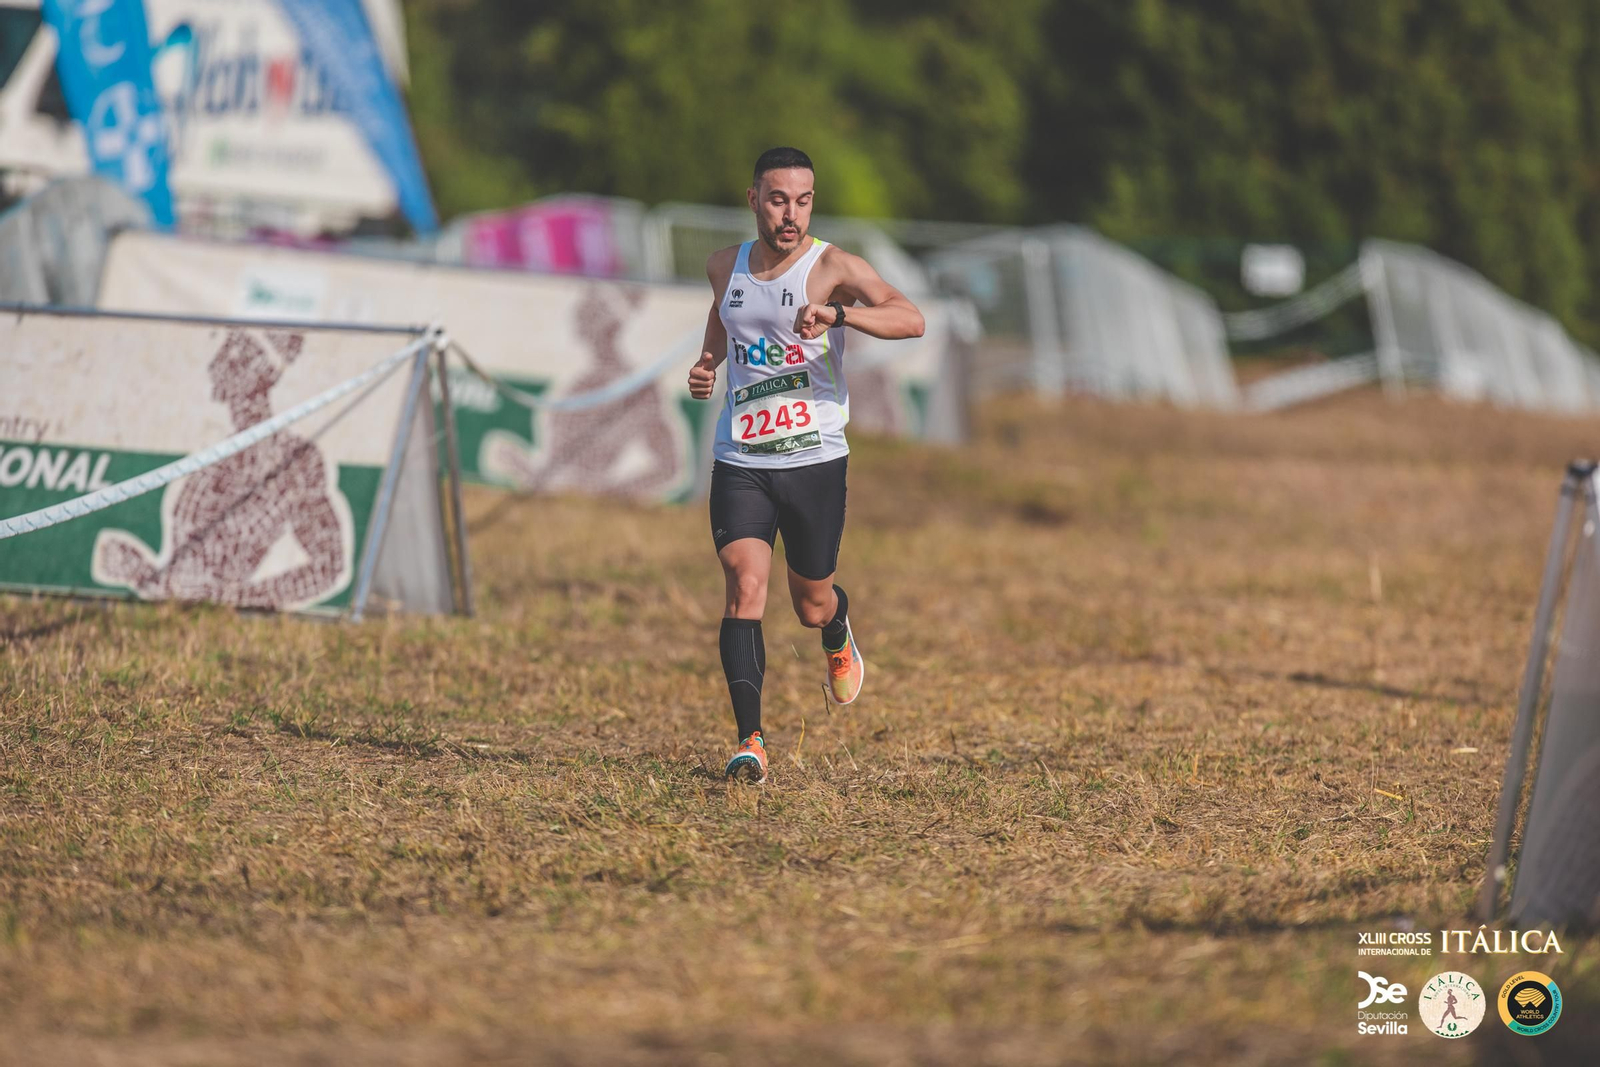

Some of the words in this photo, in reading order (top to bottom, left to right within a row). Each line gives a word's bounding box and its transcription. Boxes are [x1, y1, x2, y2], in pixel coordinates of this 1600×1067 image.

[752, 378, 788, 395] ITÁLICA
[740, 401, 811, 440] 2243
[0, 446, 112, 493] ONAL
